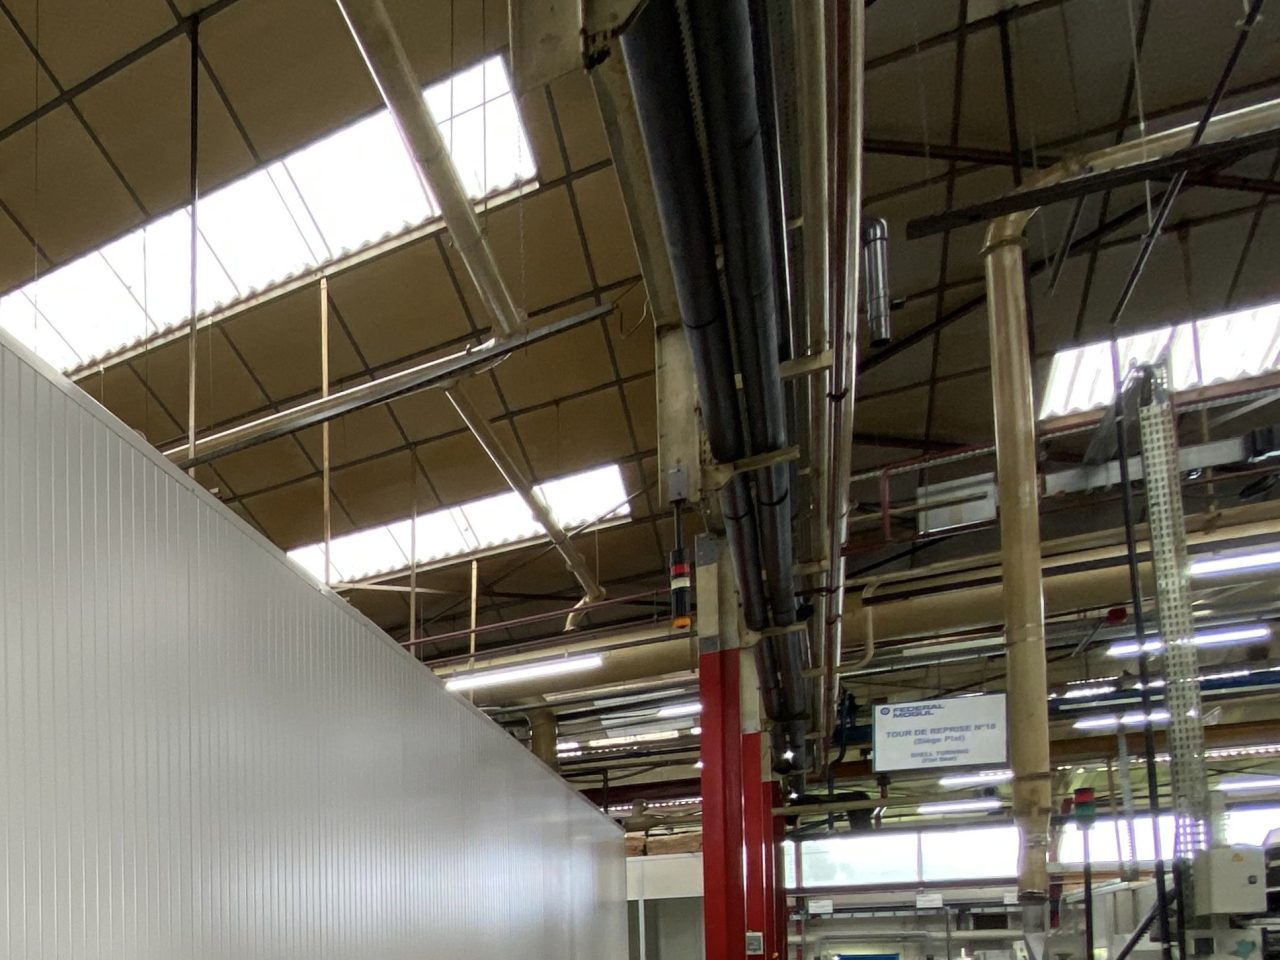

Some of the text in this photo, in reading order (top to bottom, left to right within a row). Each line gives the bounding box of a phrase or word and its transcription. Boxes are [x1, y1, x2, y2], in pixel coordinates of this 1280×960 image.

[893, 704, 944, 713] FEDERAL
[893, 710, 934, 718] MOGUL
[886, 730, 912, 738] TOUR
[930, 725, 971, 734] REPRISE
